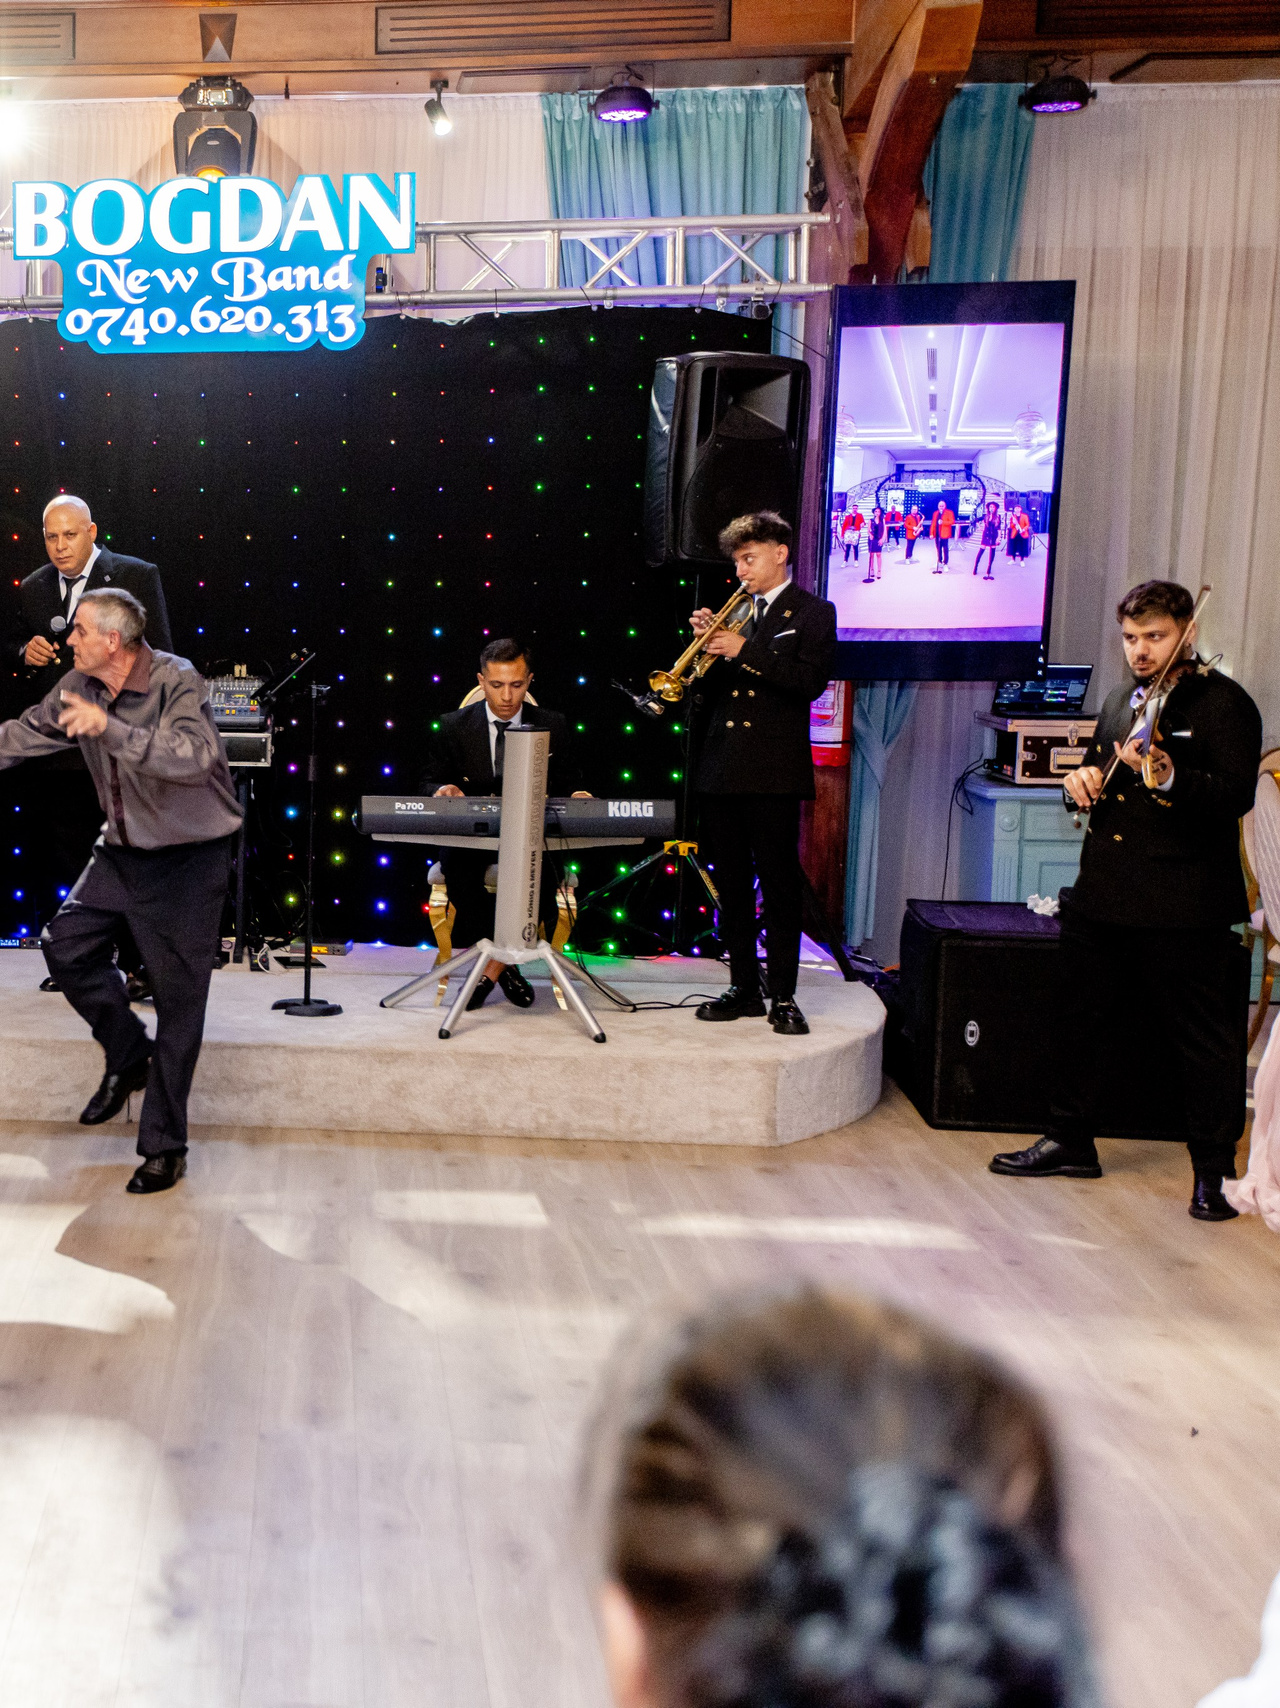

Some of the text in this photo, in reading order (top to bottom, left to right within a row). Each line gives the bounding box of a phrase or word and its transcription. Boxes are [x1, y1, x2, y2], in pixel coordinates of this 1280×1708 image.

[15, 172, 411, 257] BOGDAN
[76, 254, 356, 304] New Band
[65, 295, 356, 346] 0740.620.313
[394, 802, 425, 810] Pa700
[608, 801, 654, 817] KORG
